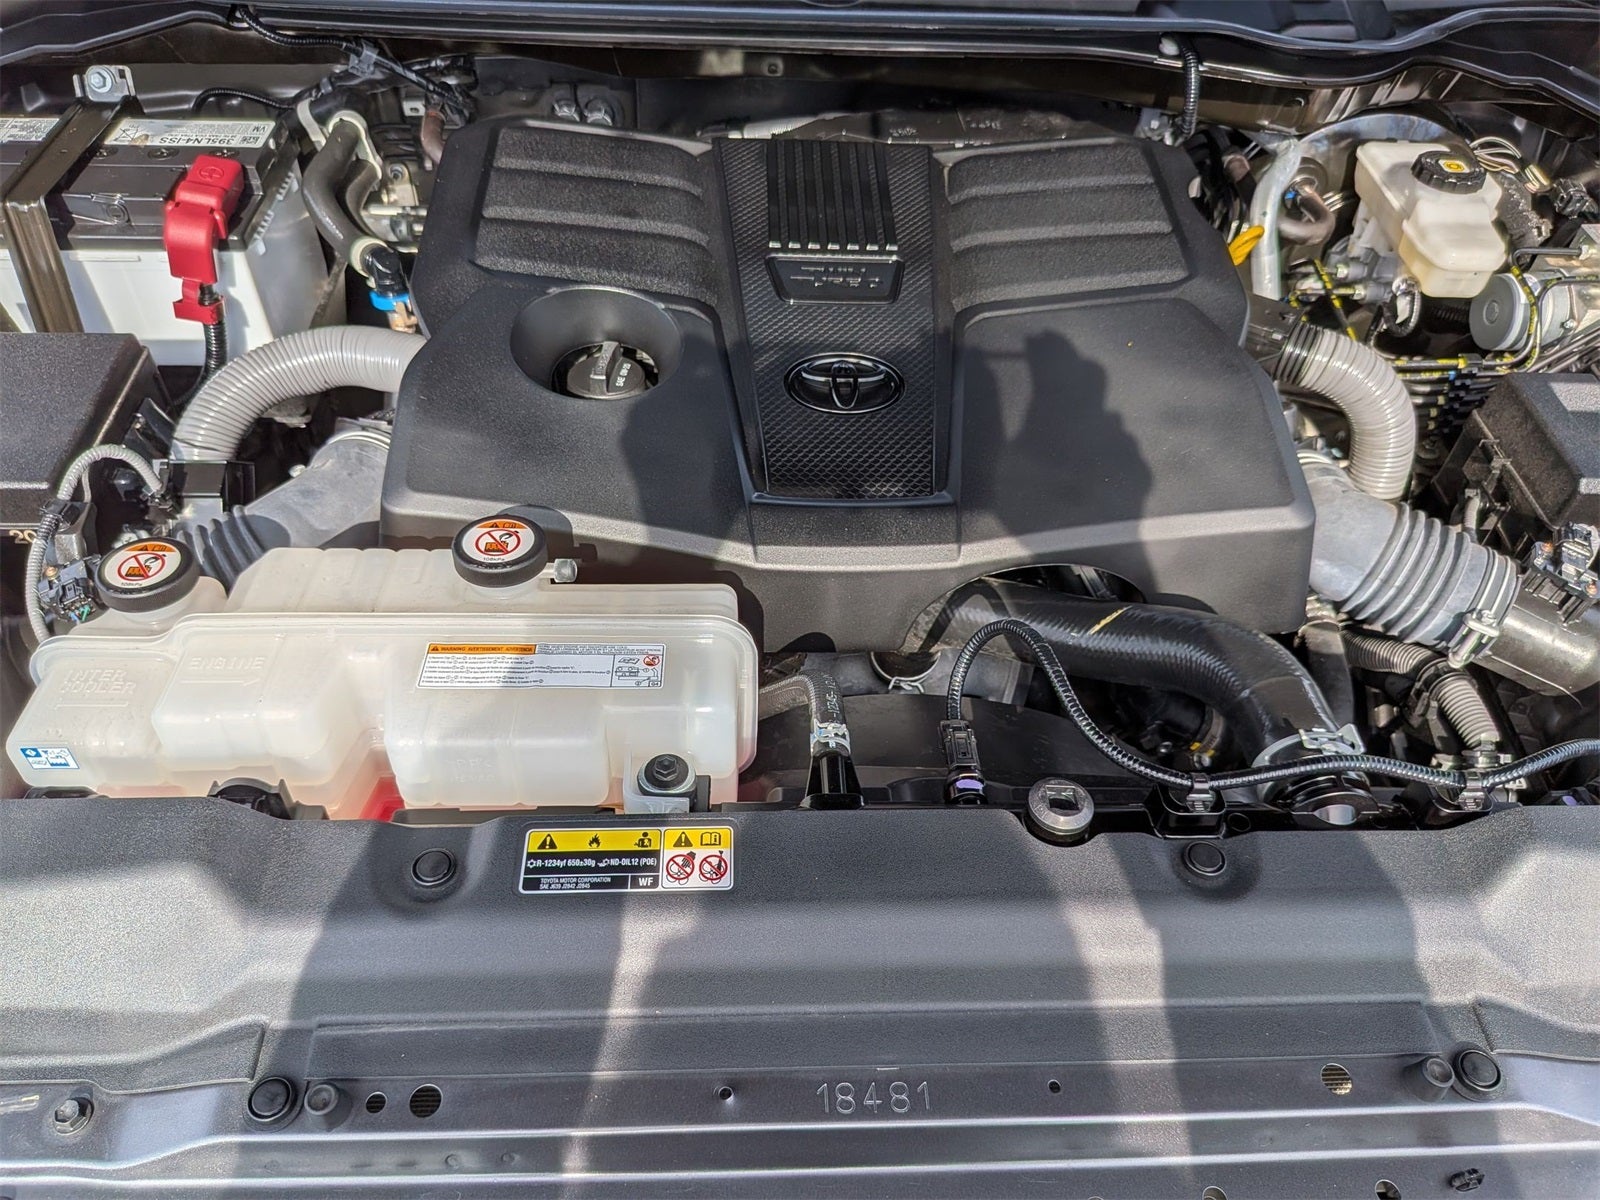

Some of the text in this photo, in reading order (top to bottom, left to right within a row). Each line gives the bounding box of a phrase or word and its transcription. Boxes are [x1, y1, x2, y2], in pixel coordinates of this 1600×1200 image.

[252, 125, 266, 133] VM
[159, 137, 235, 145] 395LN4-ISS
[616, 376, 625, 387] SAE
[189, 656, 266, 671] ENGINE
[64, 669, 127, 682] INTER
[640, 857, 657, 867] (POE)
[638, 877, 654, 887] WF
[816, 1081, 931, 1114] 18481
